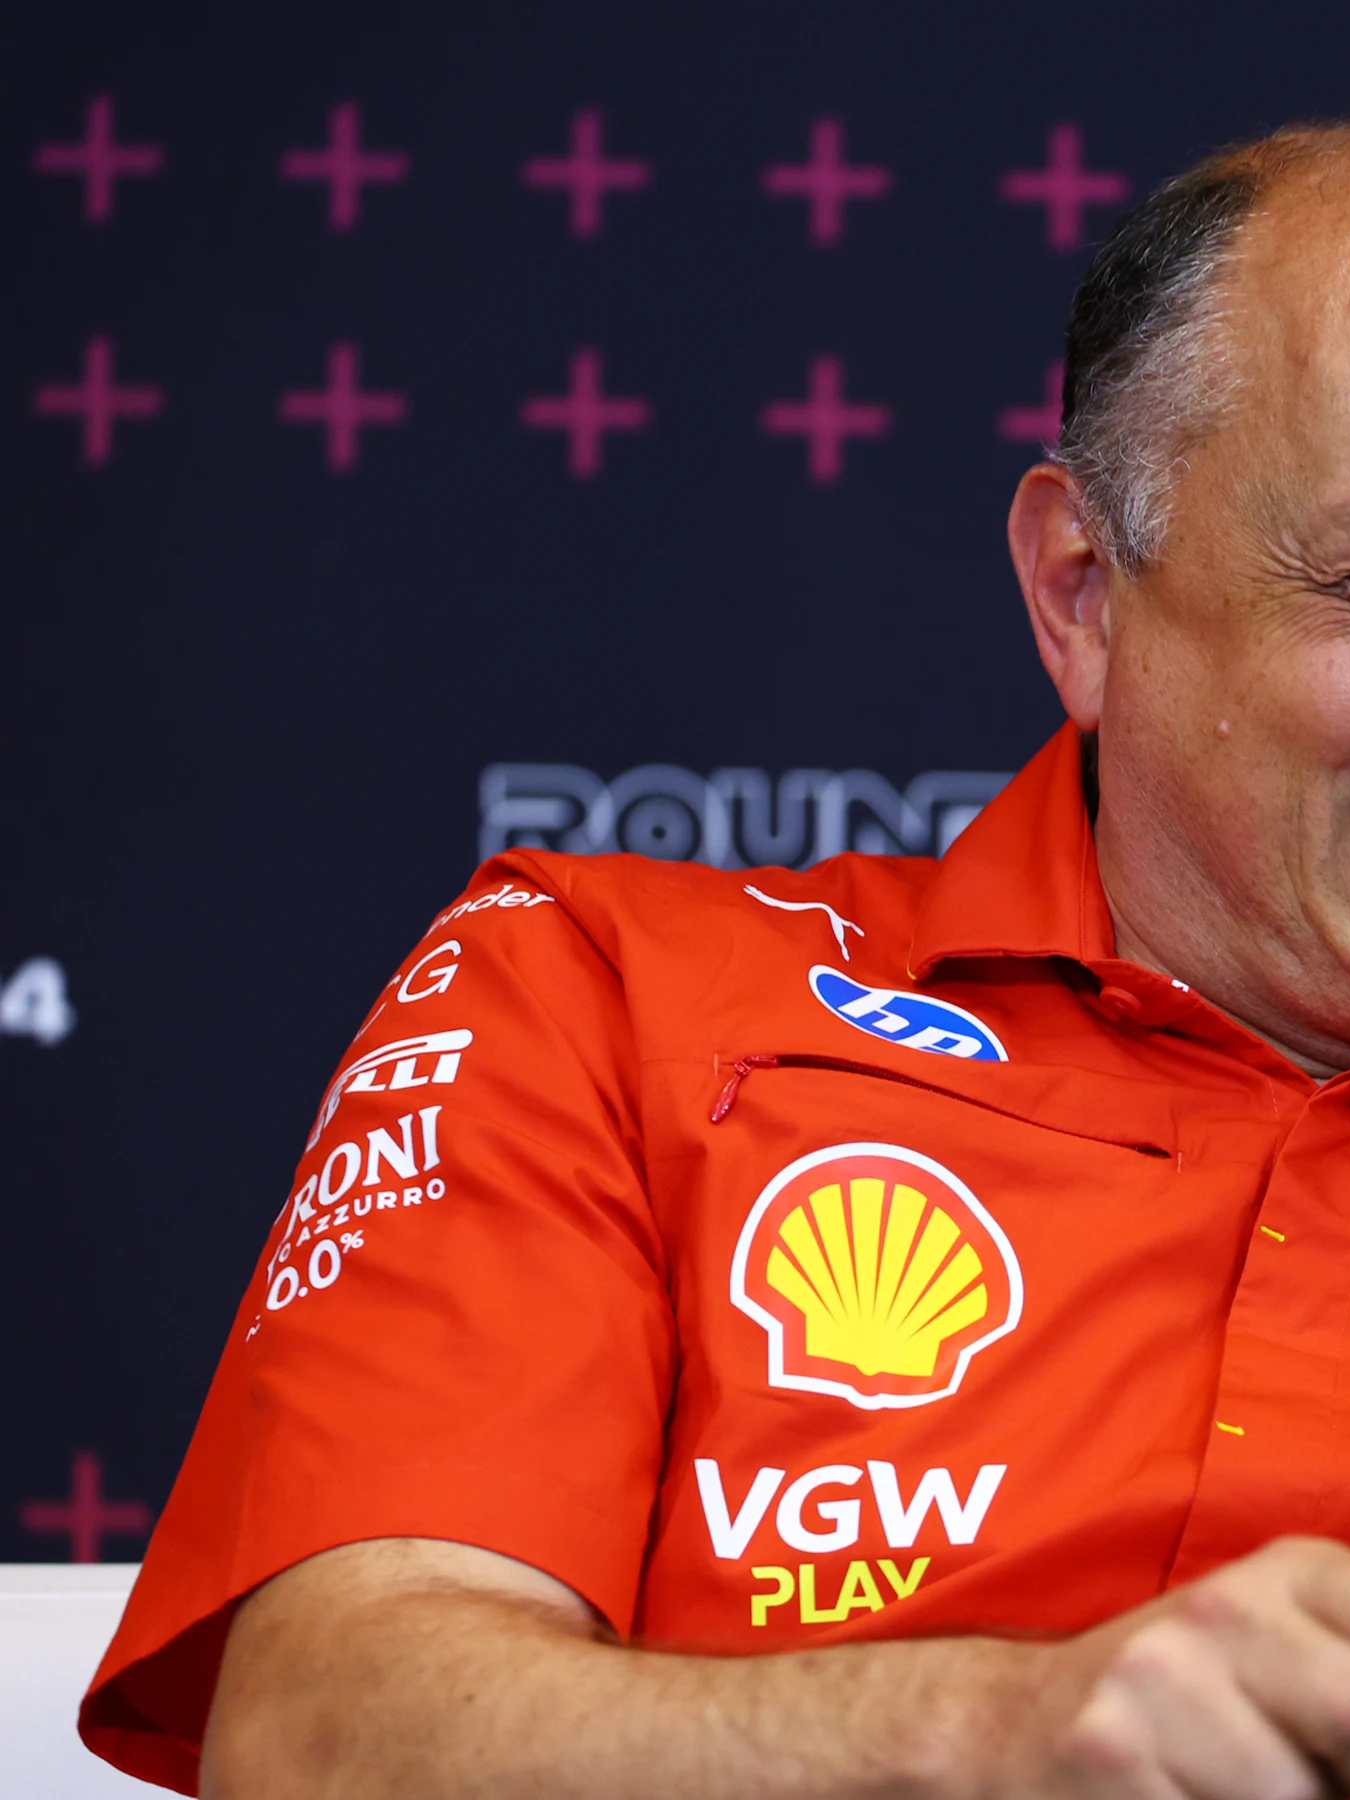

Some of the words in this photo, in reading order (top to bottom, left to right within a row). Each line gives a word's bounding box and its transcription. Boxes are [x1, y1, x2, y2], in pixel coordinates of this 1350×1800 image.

[837, 988, 984, 1059] hp
[274, 1105, 443, 1243] RONI
[296, 1178, 446, 1247] AZZURRO
[694, 1458, 1008, 1560] VGW
[751, 1557, 931, 1626] PLAY
